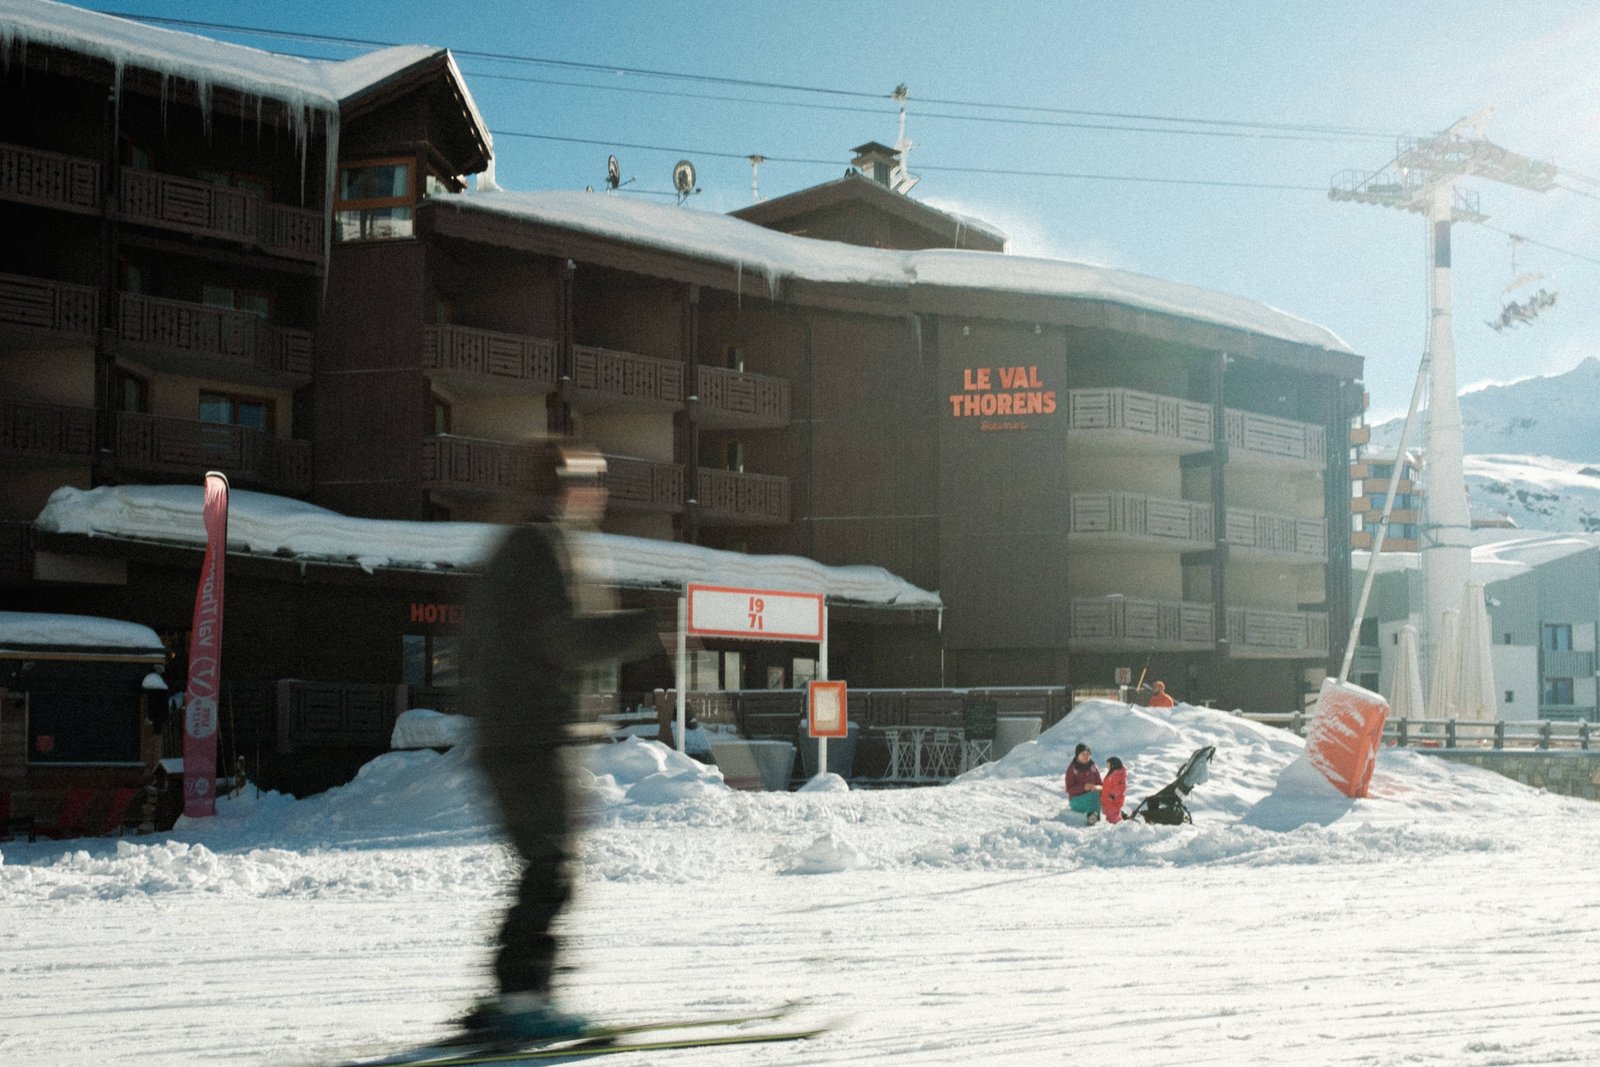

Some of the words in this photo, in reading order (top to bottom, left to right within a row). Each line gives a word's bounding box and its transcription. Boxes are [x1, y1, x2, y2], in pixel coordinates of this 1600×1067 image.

[964, 368, 991, 390] LE
[999, 366, 1043, 389] VAL
[949, 391, 1056, 417] THORENS
[749, 596, 765, 613] 19
[748, 613, 763, 630] 71
